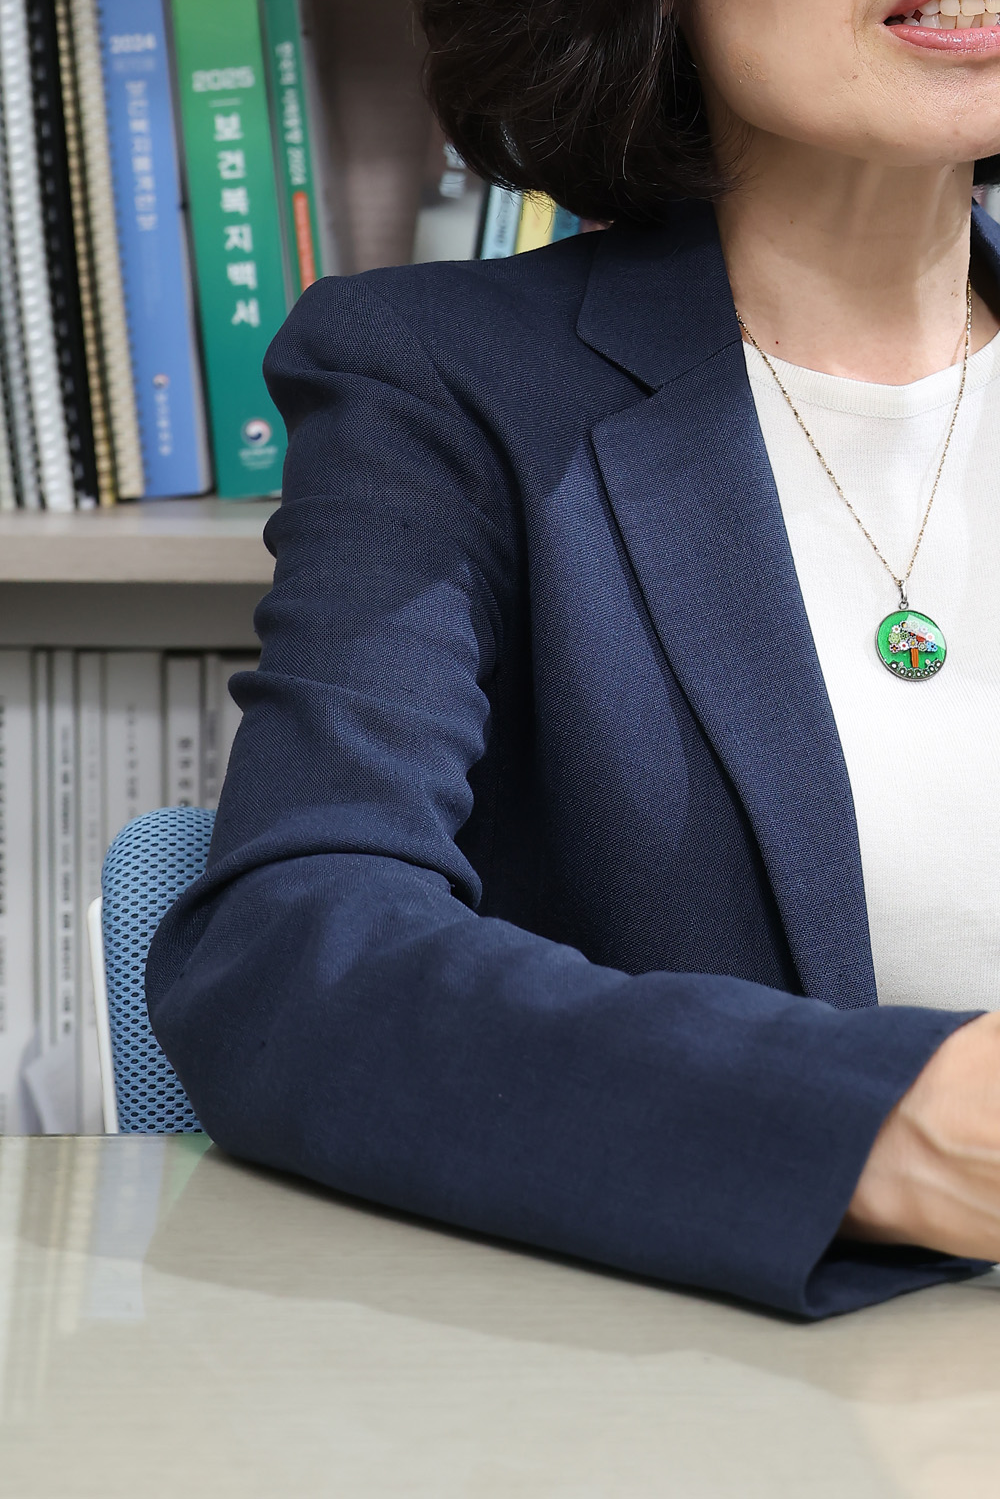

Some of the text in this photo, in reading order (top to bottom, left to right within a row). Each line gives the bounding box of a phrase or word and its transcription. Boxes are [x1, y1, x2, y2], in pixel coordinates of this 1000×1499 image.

[109, 32, 157, 55] 2024
[191, 66, 256, 93] 2025
[213, 111, 262, 329] 보건복지백서
